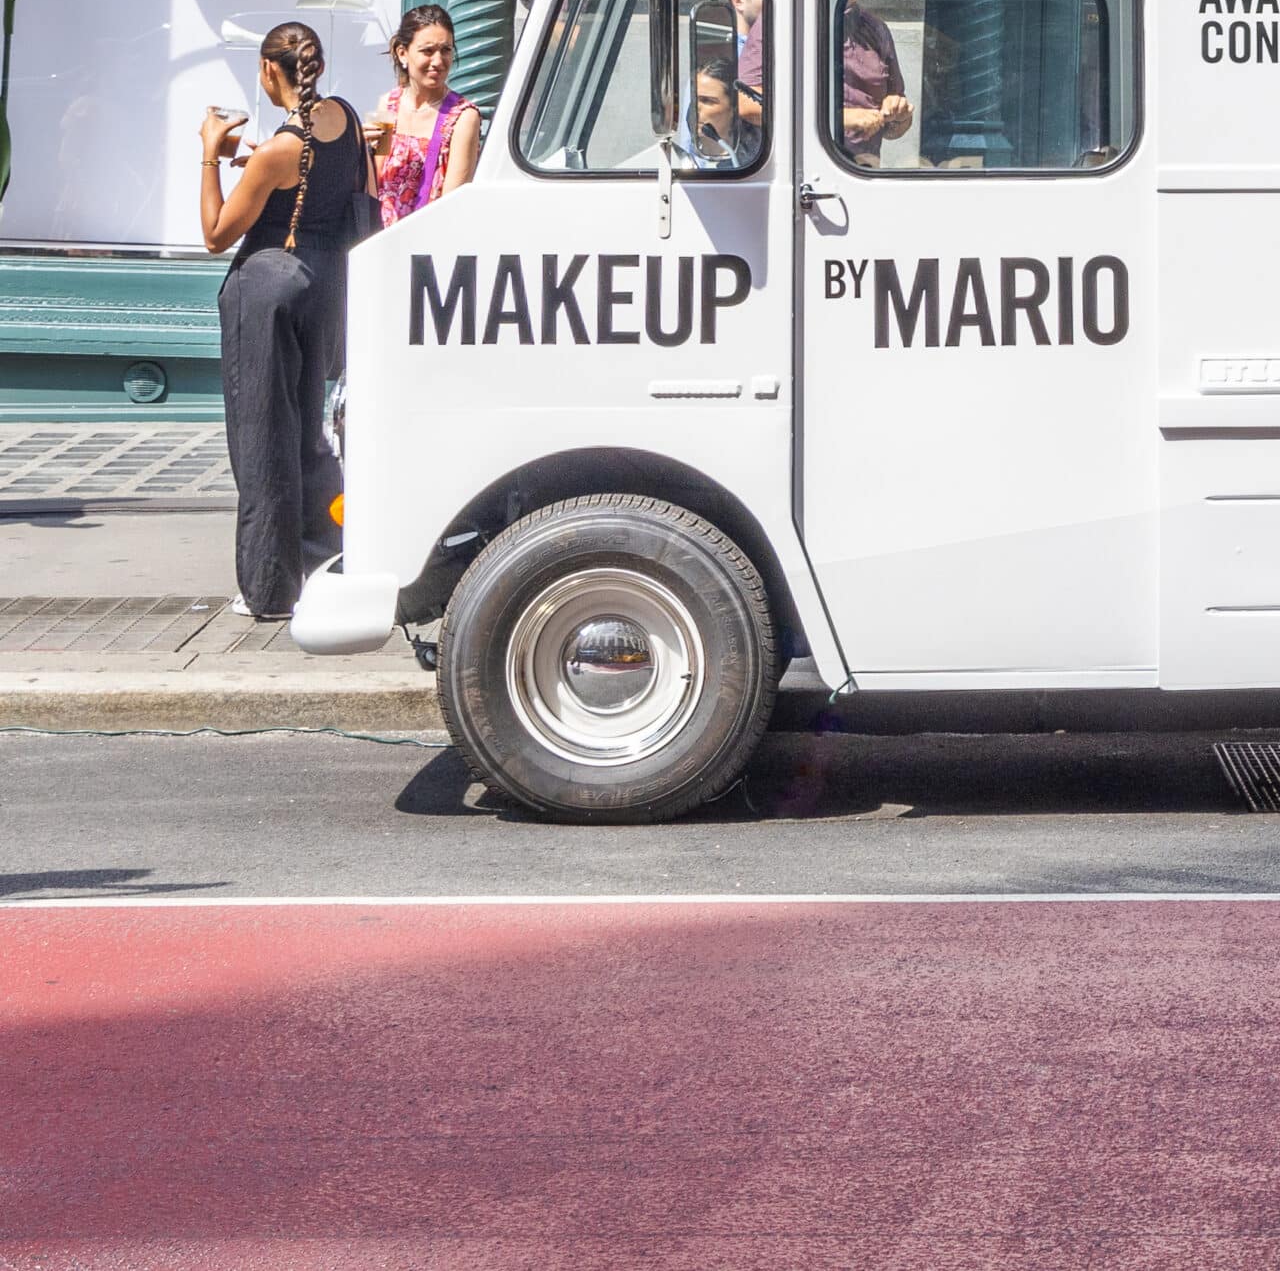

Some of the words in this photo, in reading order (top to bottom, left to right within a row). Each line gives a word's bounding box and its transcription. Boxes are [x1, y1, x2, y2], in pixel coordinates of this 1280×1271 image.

[409, 254, 752, 347] MAKEUP
[825, 259, 869, 299] BY
[874, 255, 1130, 349] MARIO
